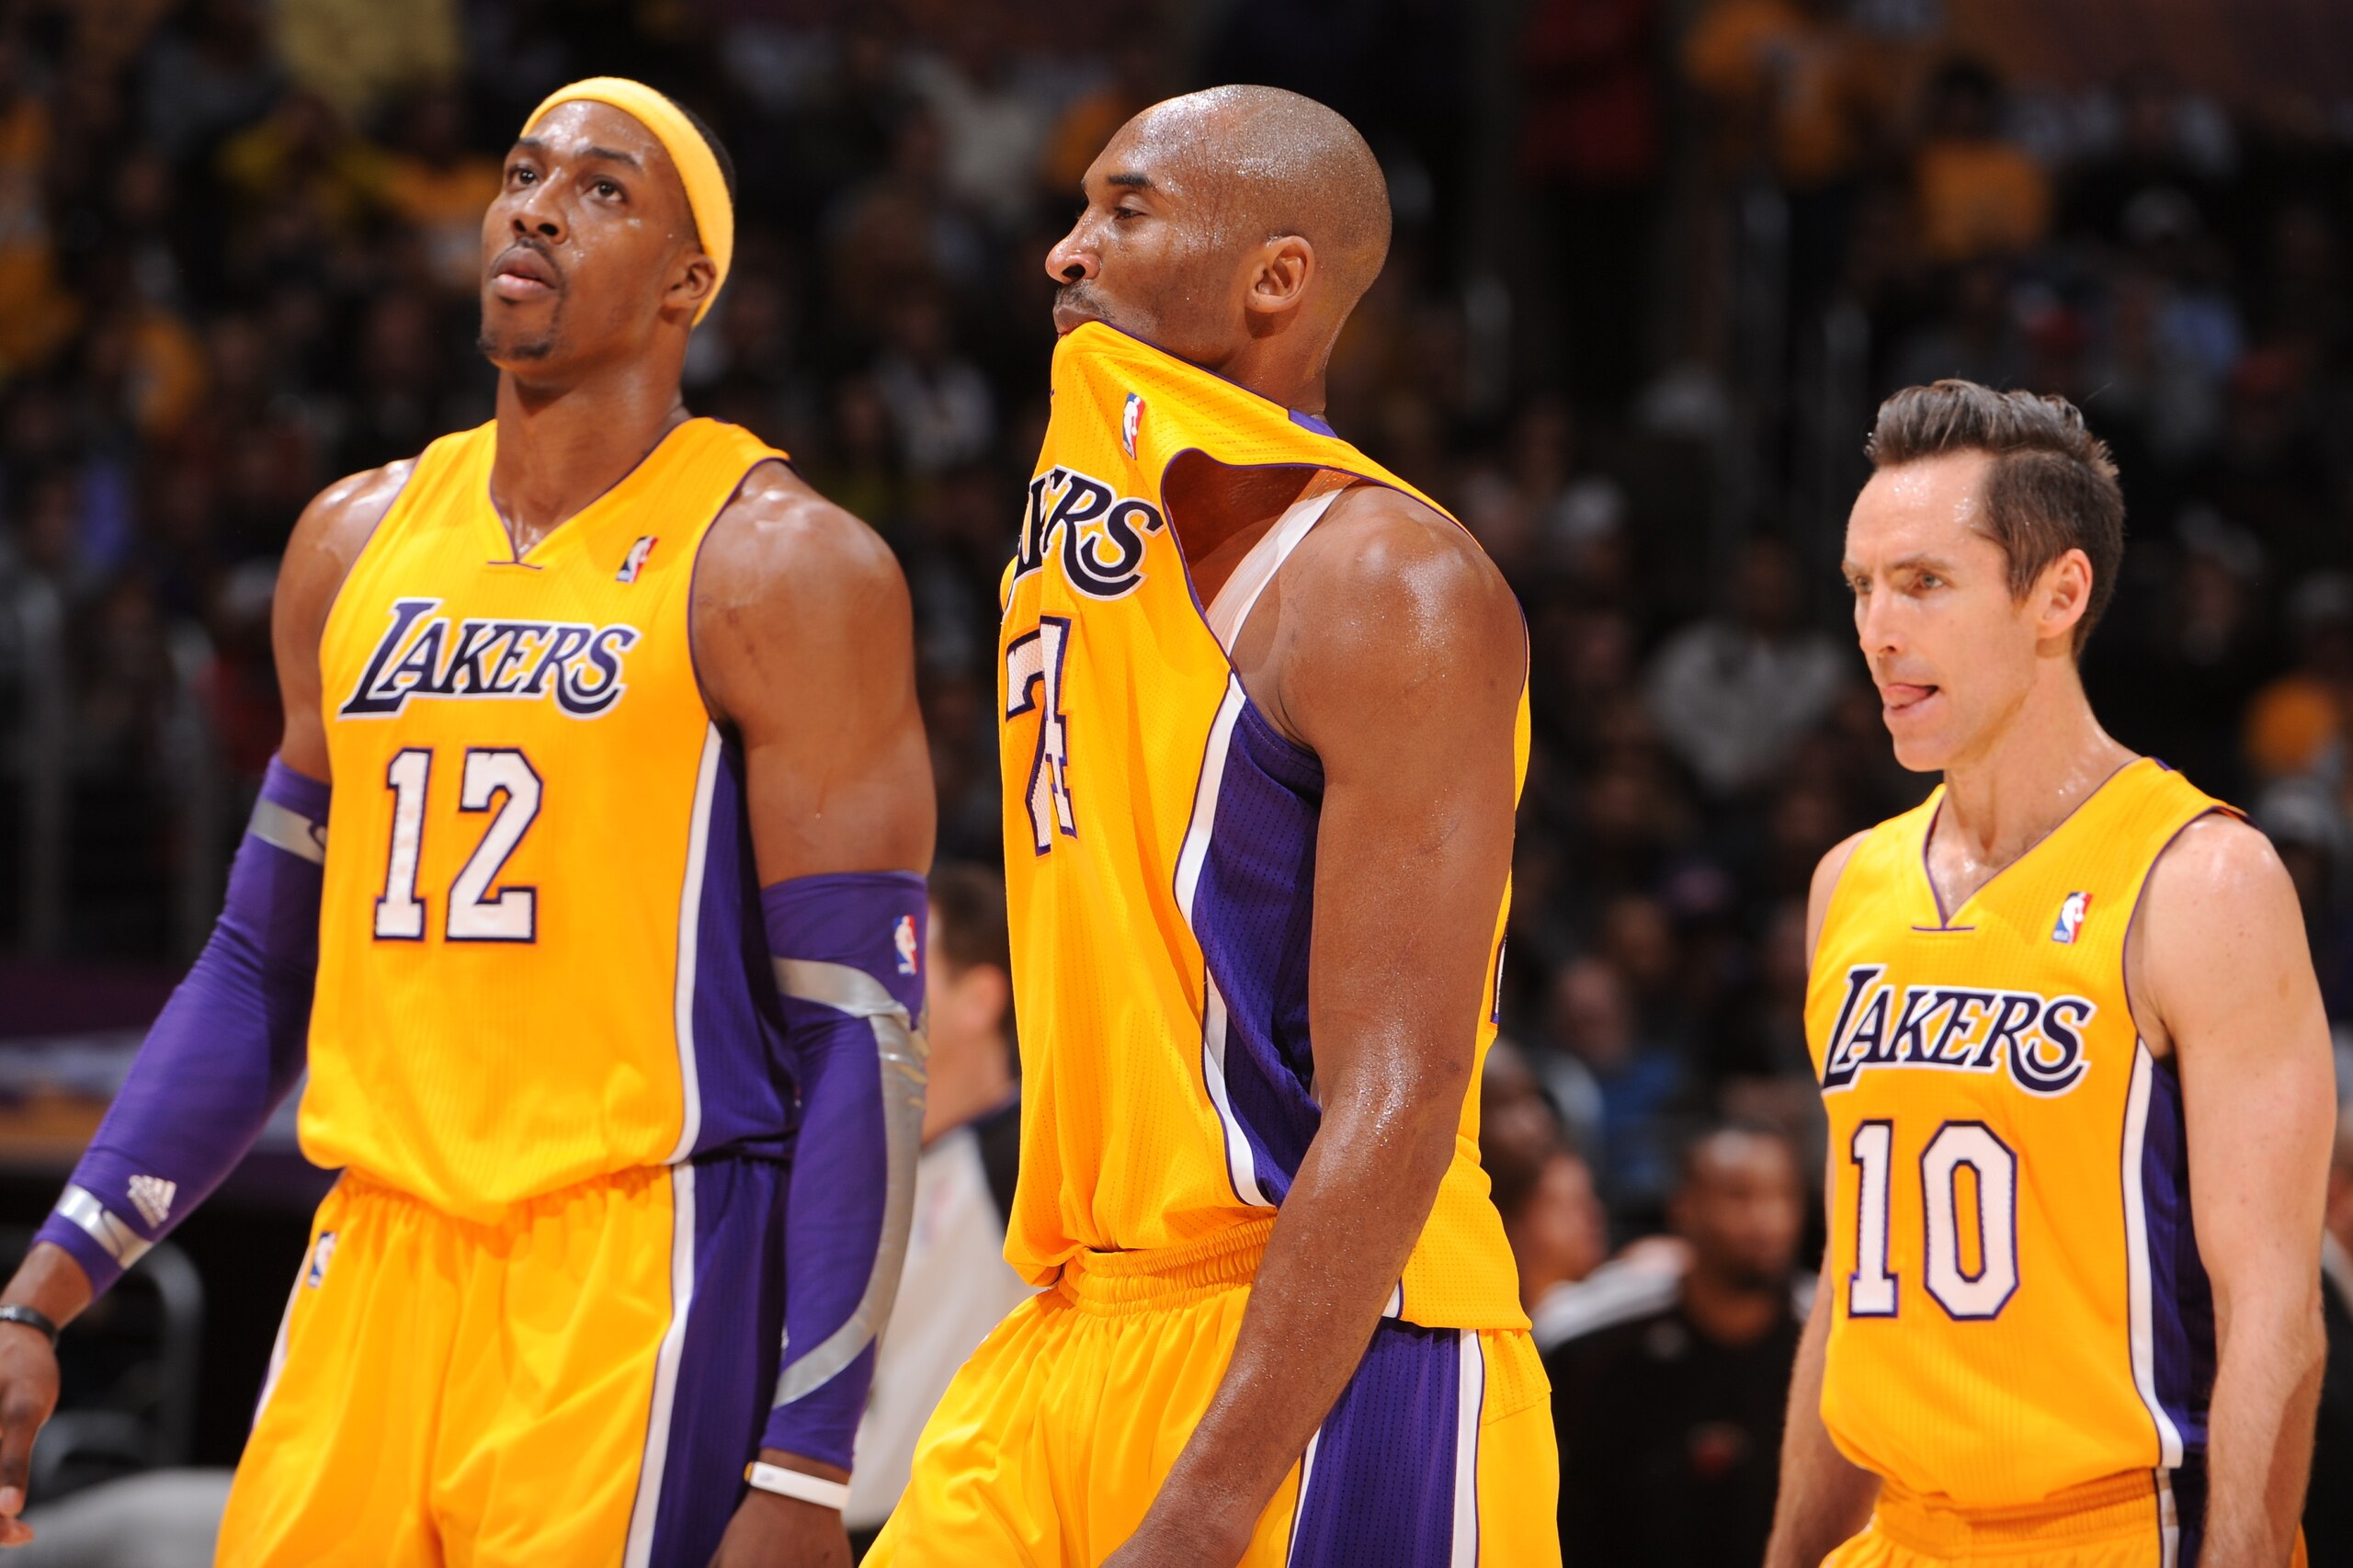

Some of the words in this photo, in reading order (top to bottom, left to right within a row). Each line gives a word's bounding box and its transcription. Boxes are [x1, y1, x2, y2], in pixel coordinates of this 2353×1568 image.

[336, 597, 643, 722] LAKERS
[372, 746, 544, 944] 12
[1821, 962, 2097, 1098] LAKERS
[1847, 1119, 2021, 1322] 10
